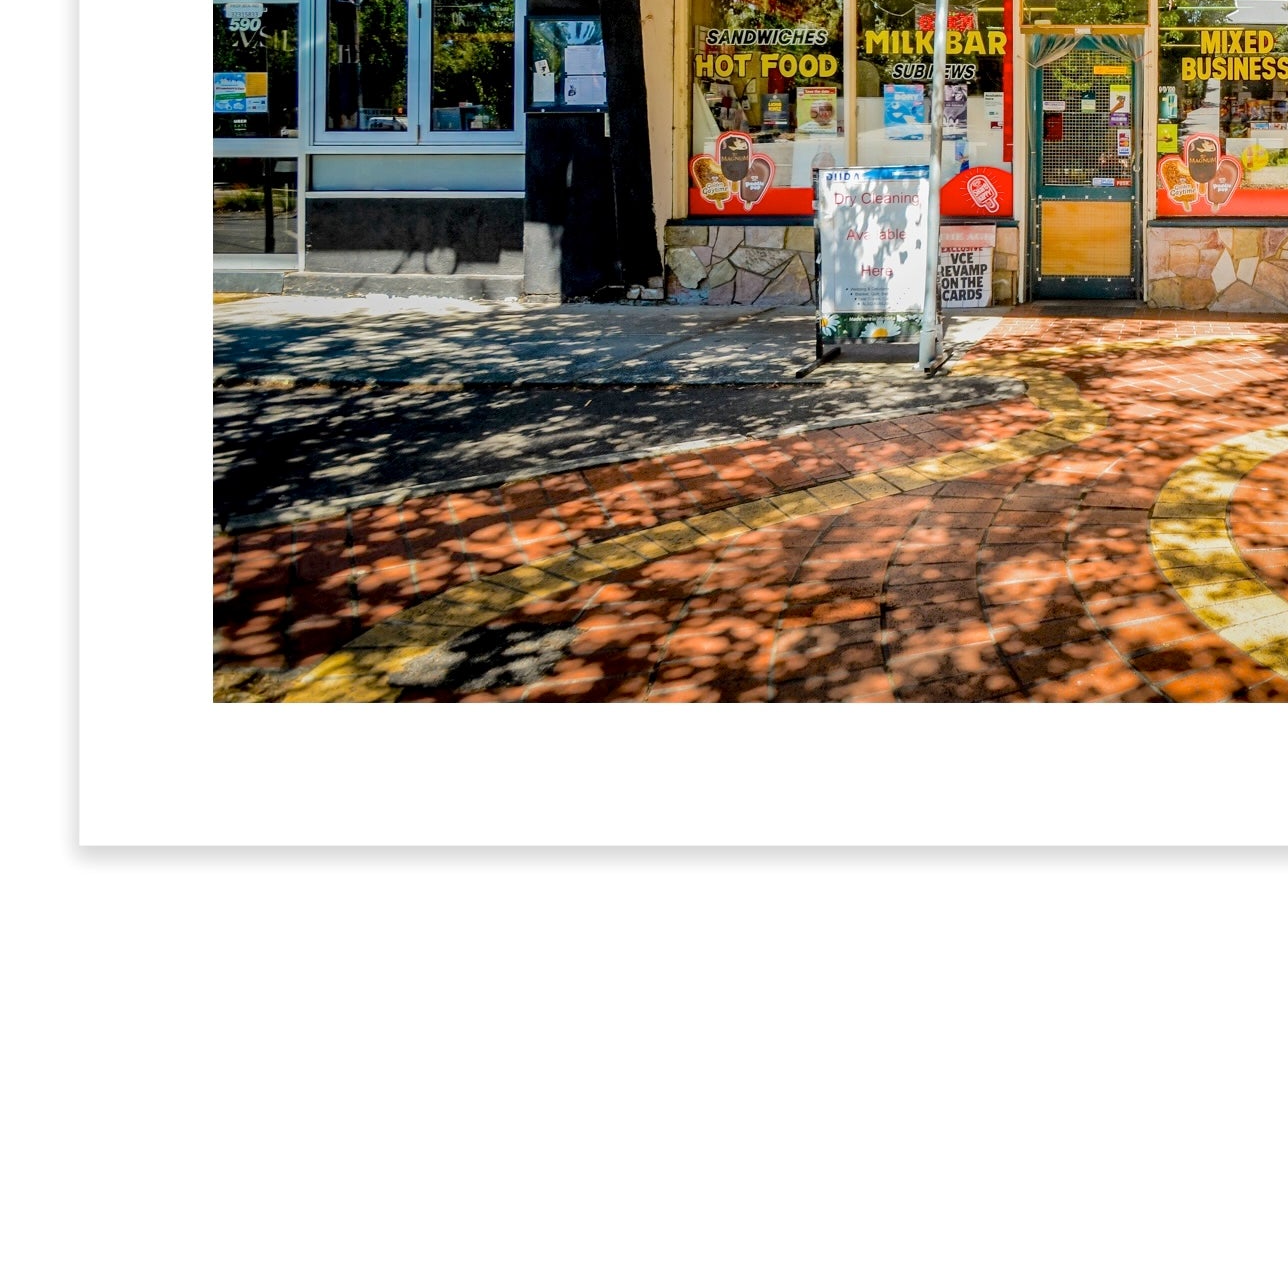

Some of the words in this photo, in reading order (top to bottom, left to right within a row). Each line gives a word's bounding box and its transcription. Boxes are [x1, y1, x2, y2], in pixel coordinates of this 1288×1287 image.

[228, 18, 262, 32] 590
[706, 28, 829, 46] SANDWICHES
[865, 30, 935, 55] MILK
[945, 30, 1008, 55] BAR
[1200, 29, 1275, 54] MIXED
[695, 53, 757, 79] HOT
[760, 53, 838, 79] FOOD
[892, 63, 927, 80] SUB
[834, 193, 857, 207] Dry
[861, 192, 920, 206] Cleaning
[950, 252, 974, 264] VCE
[861, 264, 894, 277] Here
[941, 277, 959, 289] ON
[960, 276, 984, 289] THE
[942, 289, 983, 301] CARDS
